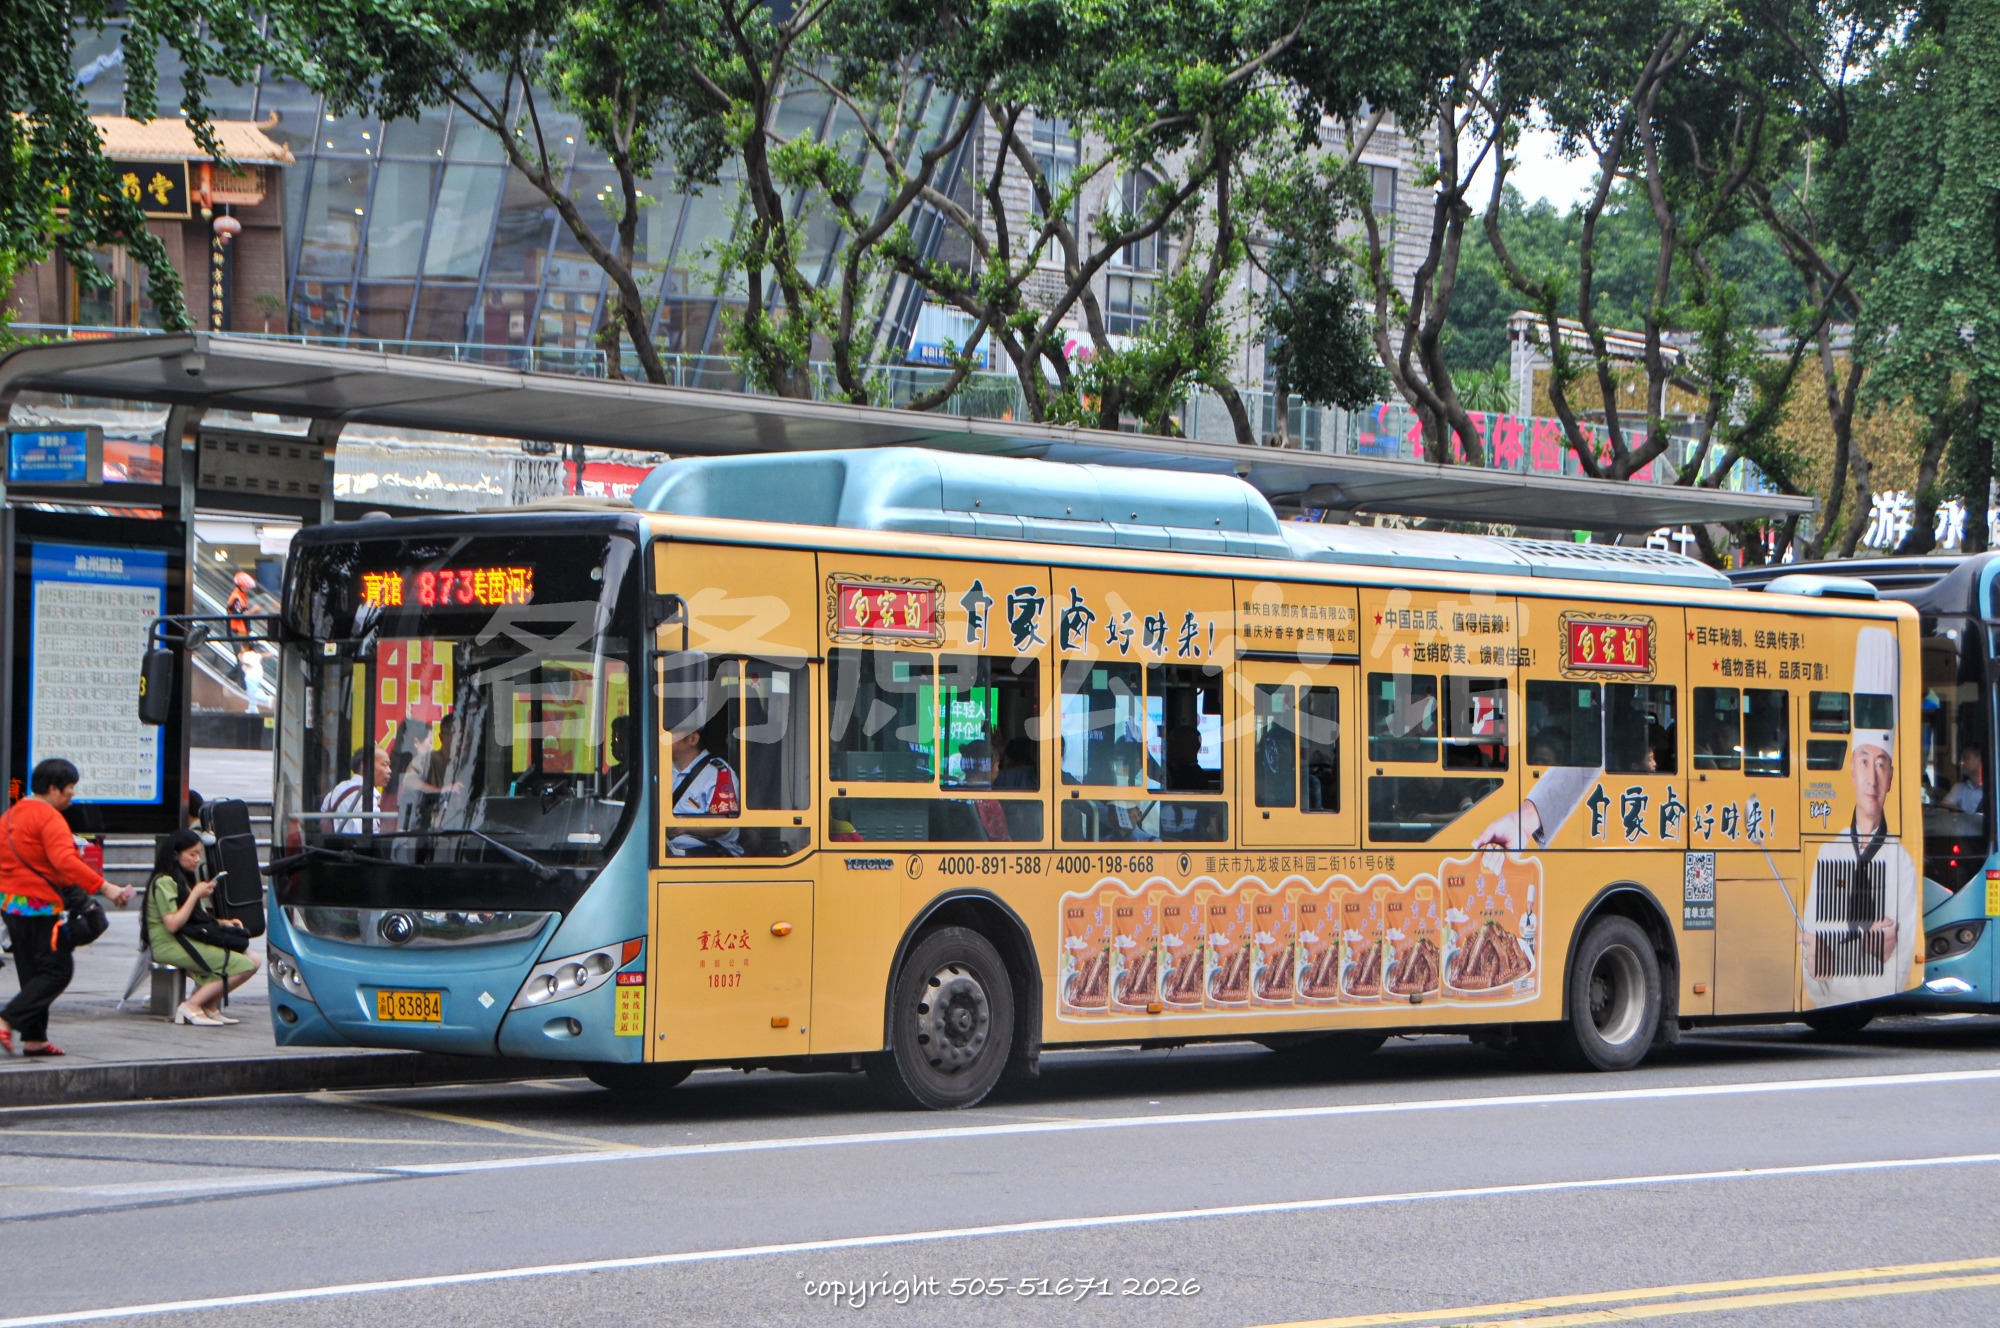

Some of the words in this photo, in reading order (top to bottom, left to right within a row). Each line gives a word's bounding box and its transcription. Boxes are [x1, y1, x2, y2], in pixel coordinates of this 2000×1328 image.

[418, 569, 474, 605] 873
[844, 858, 894, 870] YUTONG
[938, 856, 1041, 875] 4000-891-588
[1056, 855, 1154, 874] 4000-198-668
[1205, 854, 1396, 873] 重庆市九龙坡区科园二街161号6楼
[697, 929, 751, 951] 重庆公交
[709, 973, 741, 988] 18037
